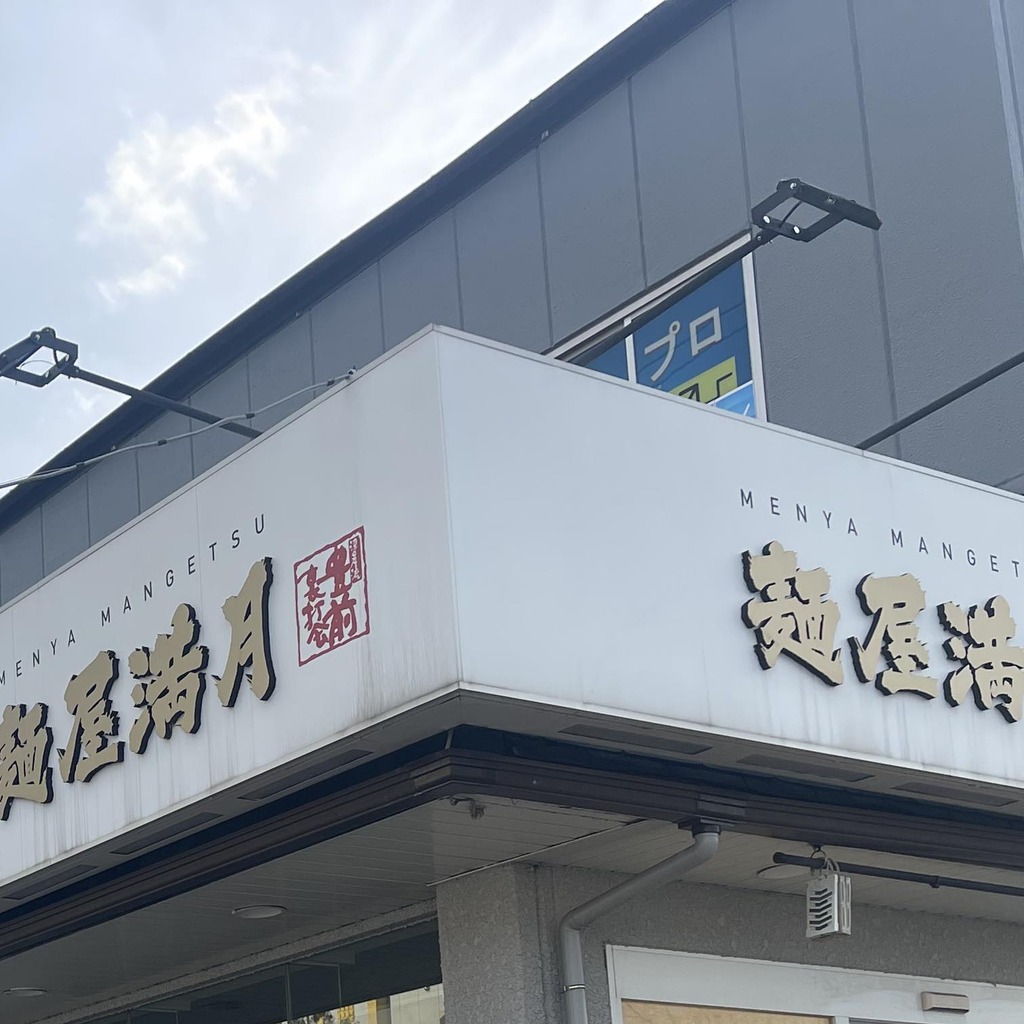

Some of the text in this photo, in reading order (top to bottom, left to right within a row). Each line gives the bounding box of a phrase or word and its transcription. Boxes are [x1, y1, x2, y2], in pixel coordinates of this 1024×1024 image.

[644, 307, 722, 382] プロ
[740, 488, 858, 536] MENYA
[101, 514, 265, 627] MANGETSU
